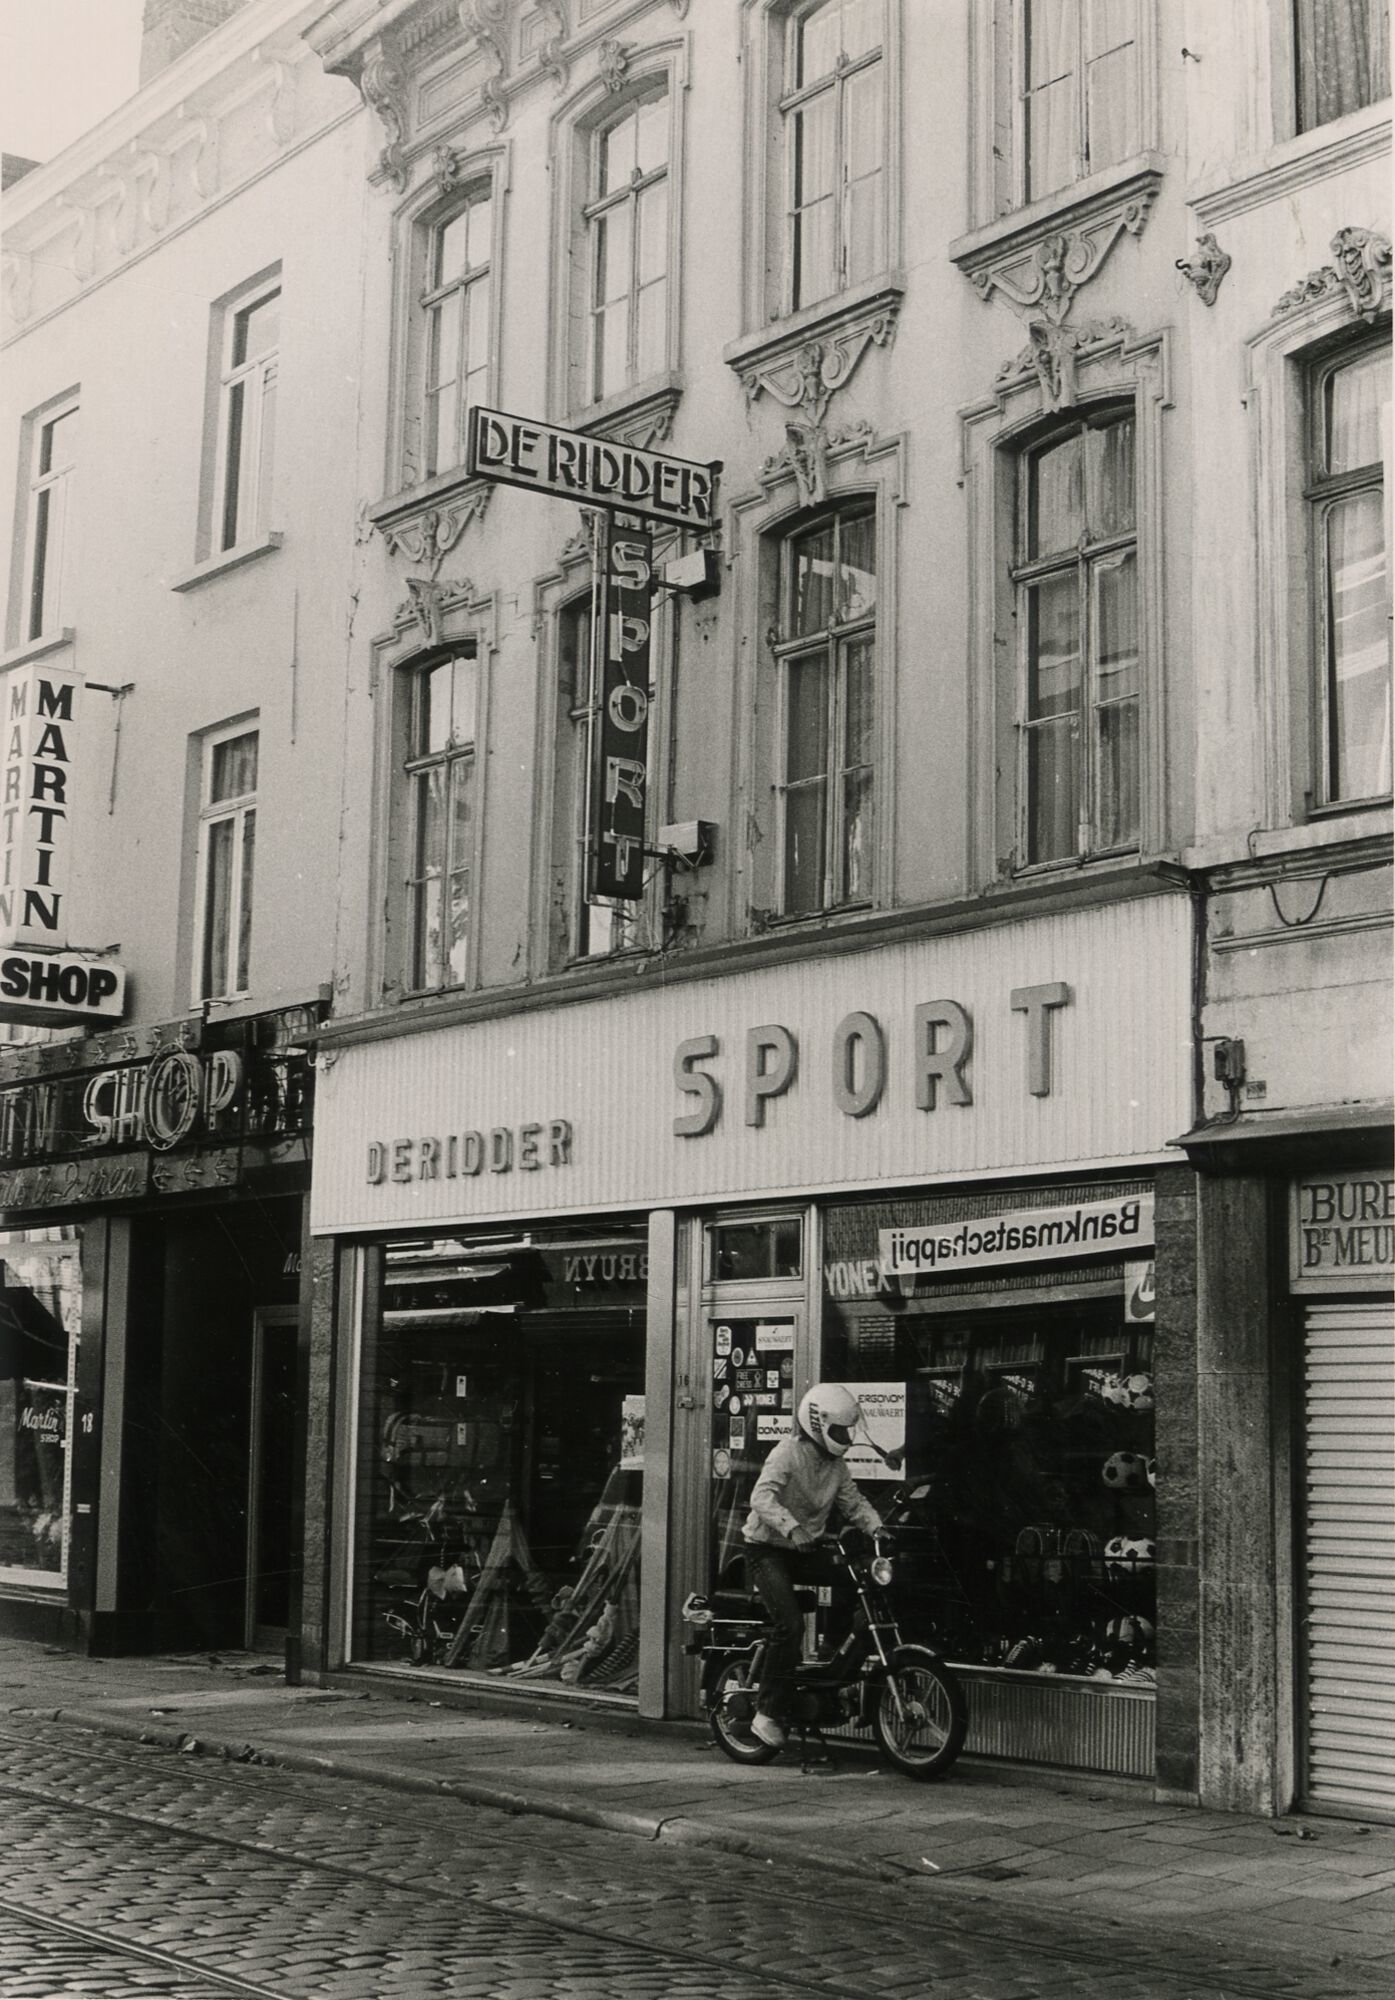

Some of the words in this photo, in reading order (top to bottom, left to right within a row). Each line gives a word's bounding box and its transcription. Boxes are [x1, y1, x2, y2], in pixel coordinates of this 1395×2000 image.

[603, 541, 651, 882] SPORT
[23, 679, 75, 931] MARTIN
[0, 957, 118, 1007] SHOP
[672, 981, 1070, 1138] SPORT
[366, 1119, 573, 1184] DERIDDER
[1334, 1225, 1395, 1266] MEU
[824, 1259, 892, 1296] YONEX
[81, 1412, 94, 1433] 18
[757, 1426, 793, 1434] DONNAY
[808, 1402, 822, 1434] LAZER
